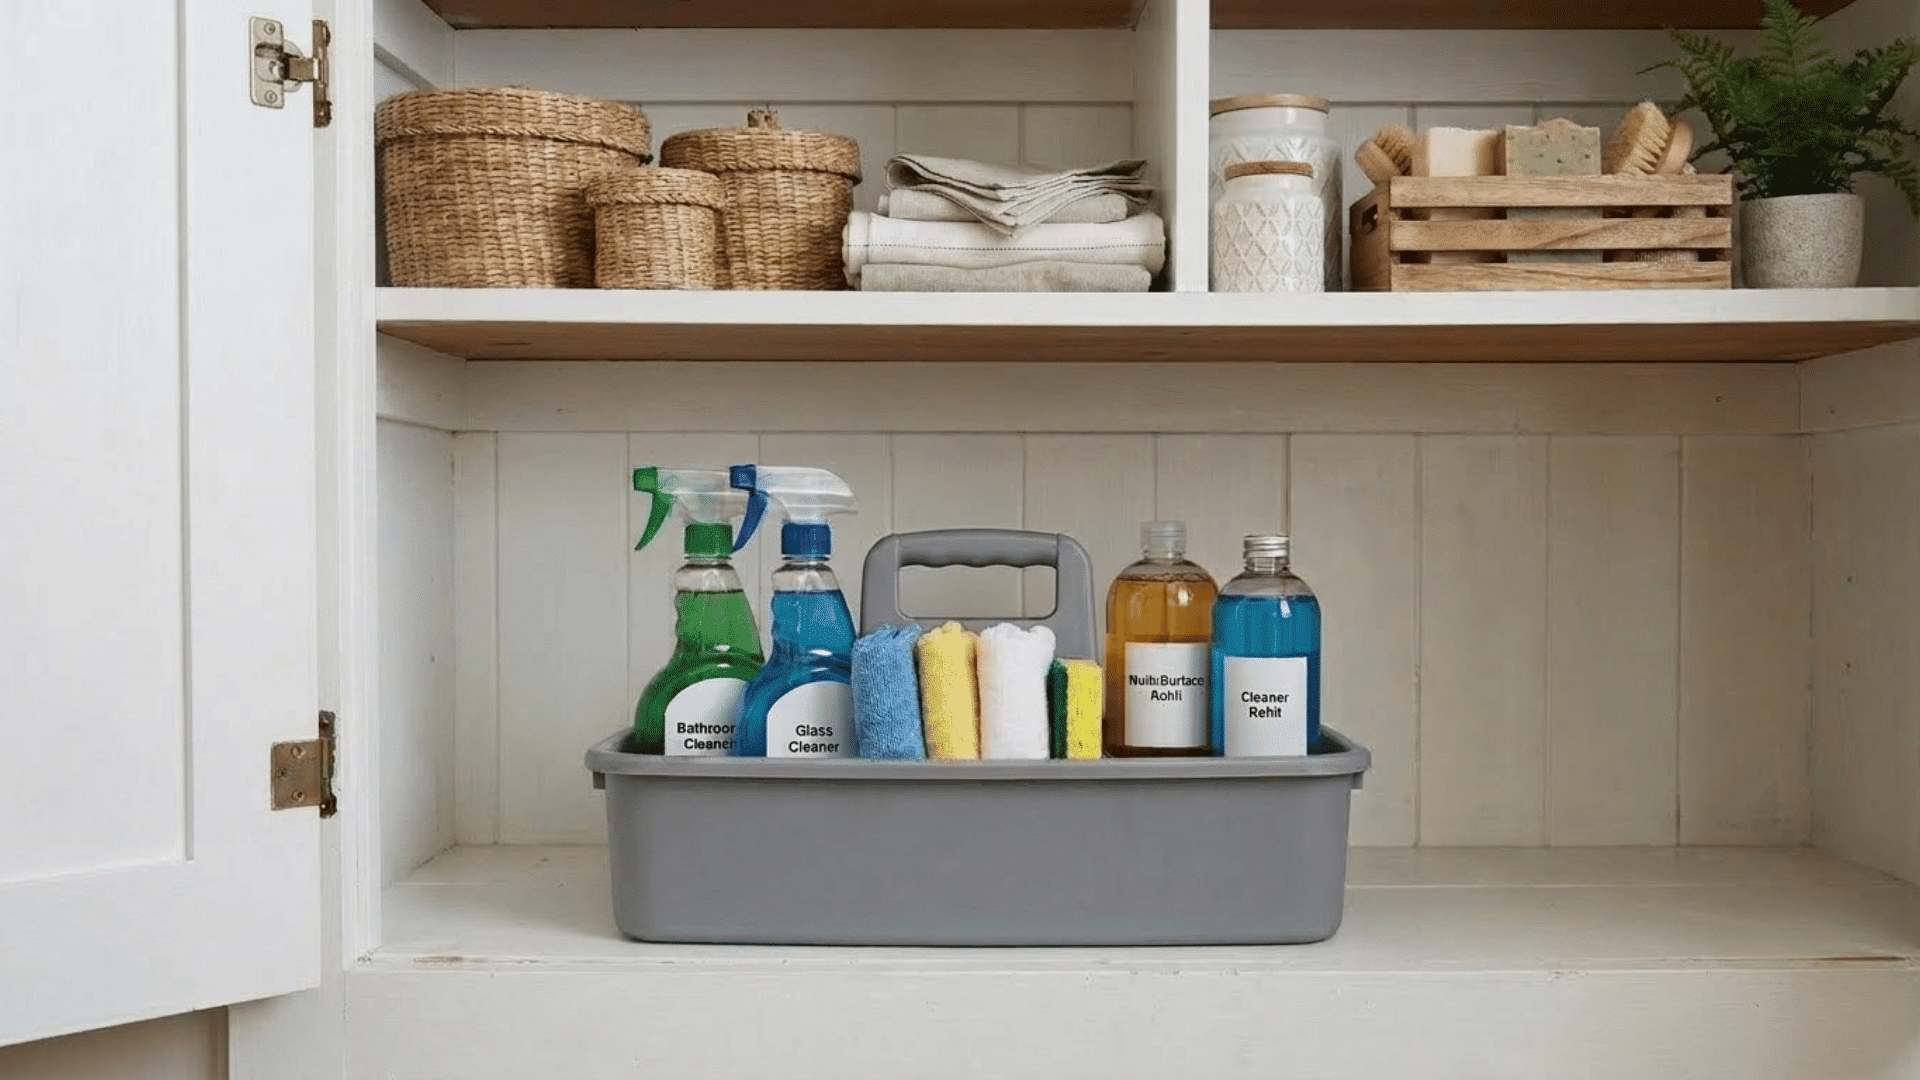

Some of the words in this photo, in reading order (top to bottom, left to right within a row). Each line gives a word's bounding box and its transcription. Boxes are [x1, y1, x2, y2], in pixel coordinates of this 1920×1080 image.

[1241, 691, 1289, 703] Cleaner
[1249, 706, 1282, 718] Rehit
[795, 724, 834, 737] Glass
[788, 741, 840, 753] Cleaner
